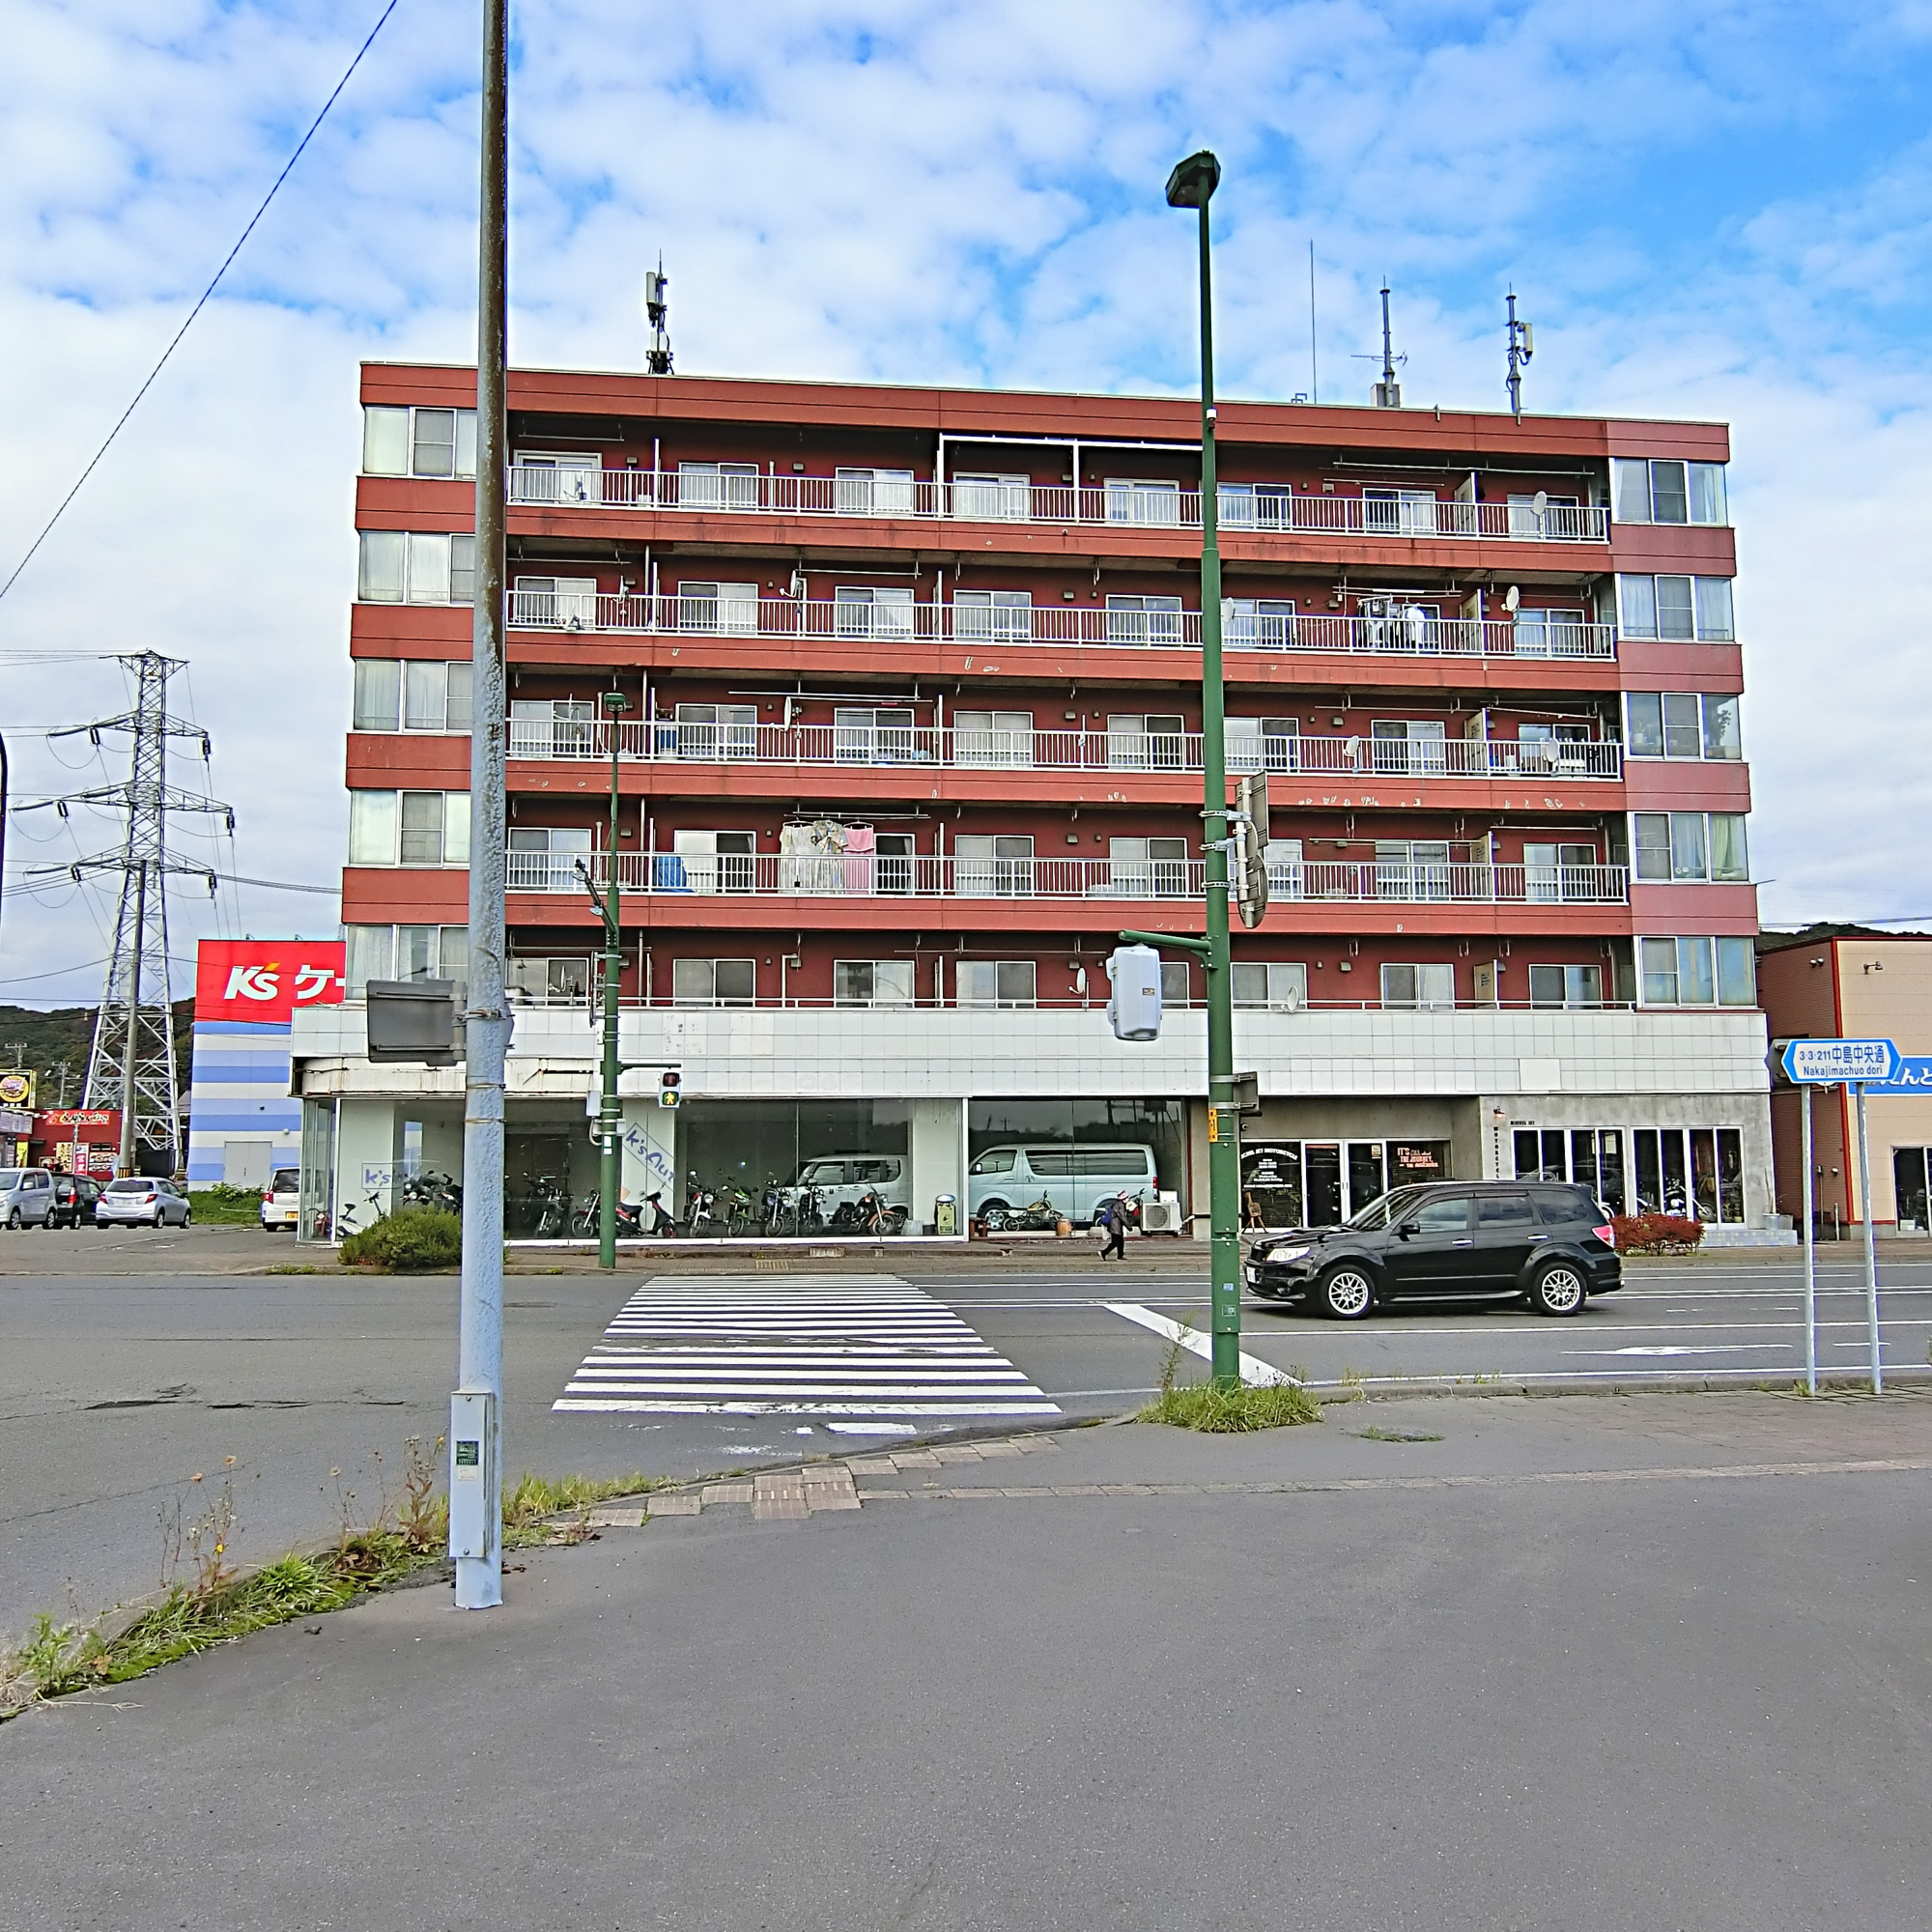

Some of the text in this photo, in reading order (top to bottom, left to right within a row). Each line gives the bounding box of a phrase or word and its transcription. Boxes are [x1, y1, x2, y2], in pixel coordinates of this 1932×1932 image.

[224, 963, 280, 1001] K's
[295, 964, 345, 1000] ケ
[1804, 1065, 1883, 1077] Nakajimachuo dori
